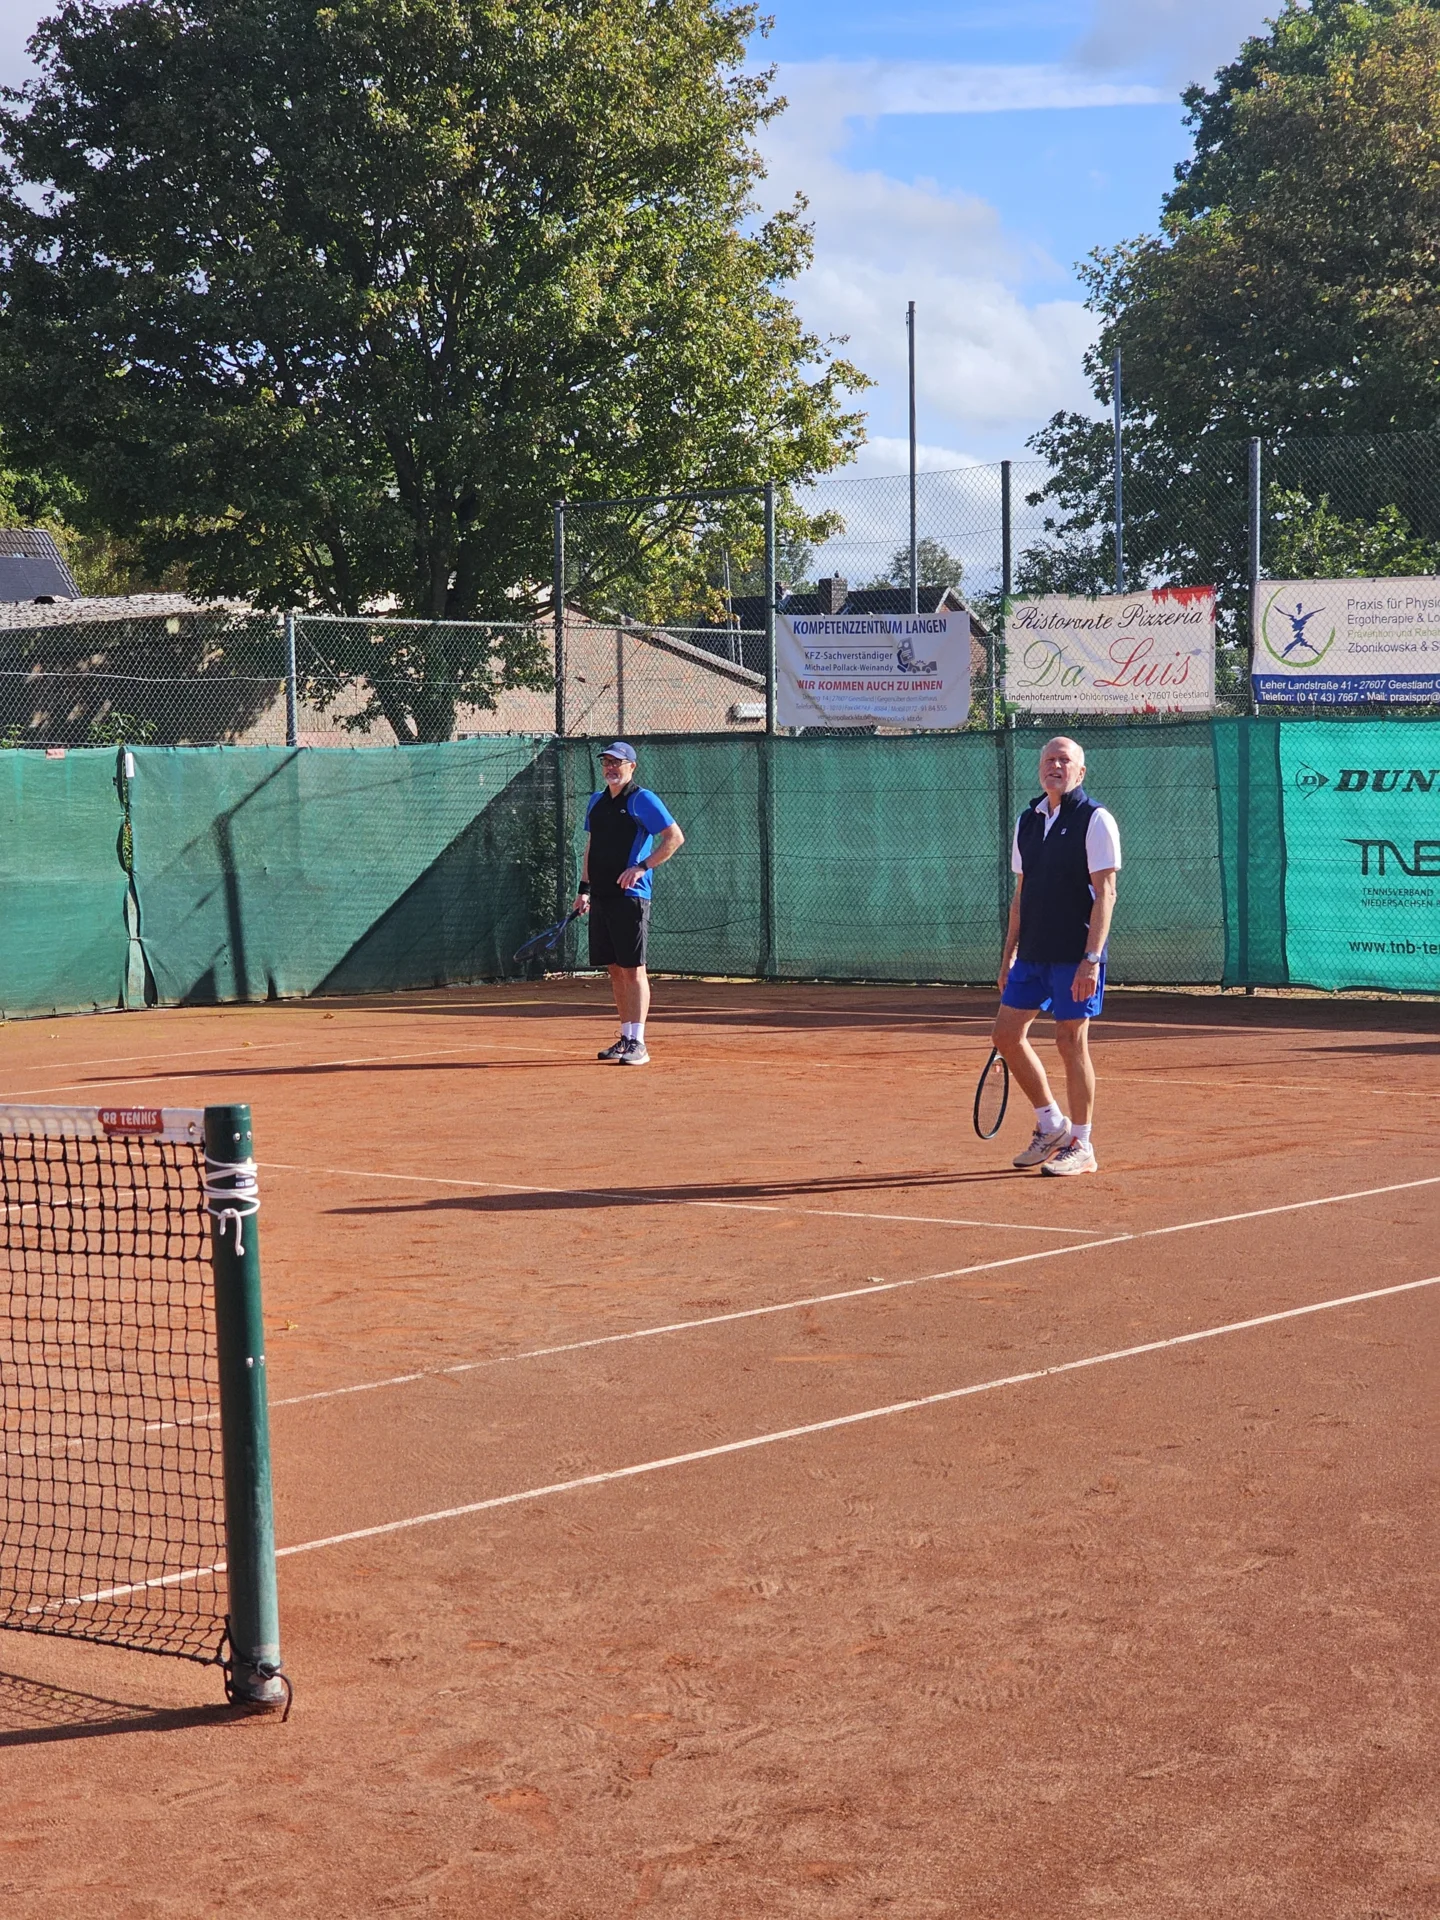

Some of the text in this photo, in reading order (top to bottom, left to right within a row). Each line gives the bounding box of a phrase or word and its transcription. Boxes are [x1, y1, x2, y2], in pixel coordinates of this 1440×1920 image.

[1347, 598, 1383, 610] Praxis
[1387, 597, 1402, 609] für
[1012, 603, 1202, 630] Ristorante Pizzeria
[1347, 613, 1414, 627] Ergotherapie
[1416, 612, 1424, 623] &
[793, 619, 947, 635] KOMPETENZZENTRUM LANGEN
[1348, 642, 1417, 653] Zbonikowska
[1420, 640, 1428, 651] &
[804, 651, 893, 661] KFZ-Sachverständiger
[1017, 637, 1191, 688] Da Luis
[804, 663, 894, 672] Michael Pollack-Weinandy
[796, 680, 943, 691] WIR KOMMEN AUCH ZU IHNEN
[1260, 680, 1286, 689] Leher
[1288, 680, 1339, 690] Landstraße
[1340, 680, 1352, 690] 41
[1359, 680, 1386, 690] 27607
[1388, 680, 1434, 689] Geestland
[1147, 691, 1171, 700] 27607
[1172, 691, 1210, 699] Geestland
[1260, 691, 1295, 701] Telefon:
[1320, 692, 1336, 703] 43)
[1366, 691, 1388, 701] Mail:
[1333, 769, 1440, 793] DUN
[1362, 887, 1434, 897] TENNISVERBAND
[1348, 939, 1440, 955] www.tnb-te
[120, 1111, 157, 1126] TENNIS
